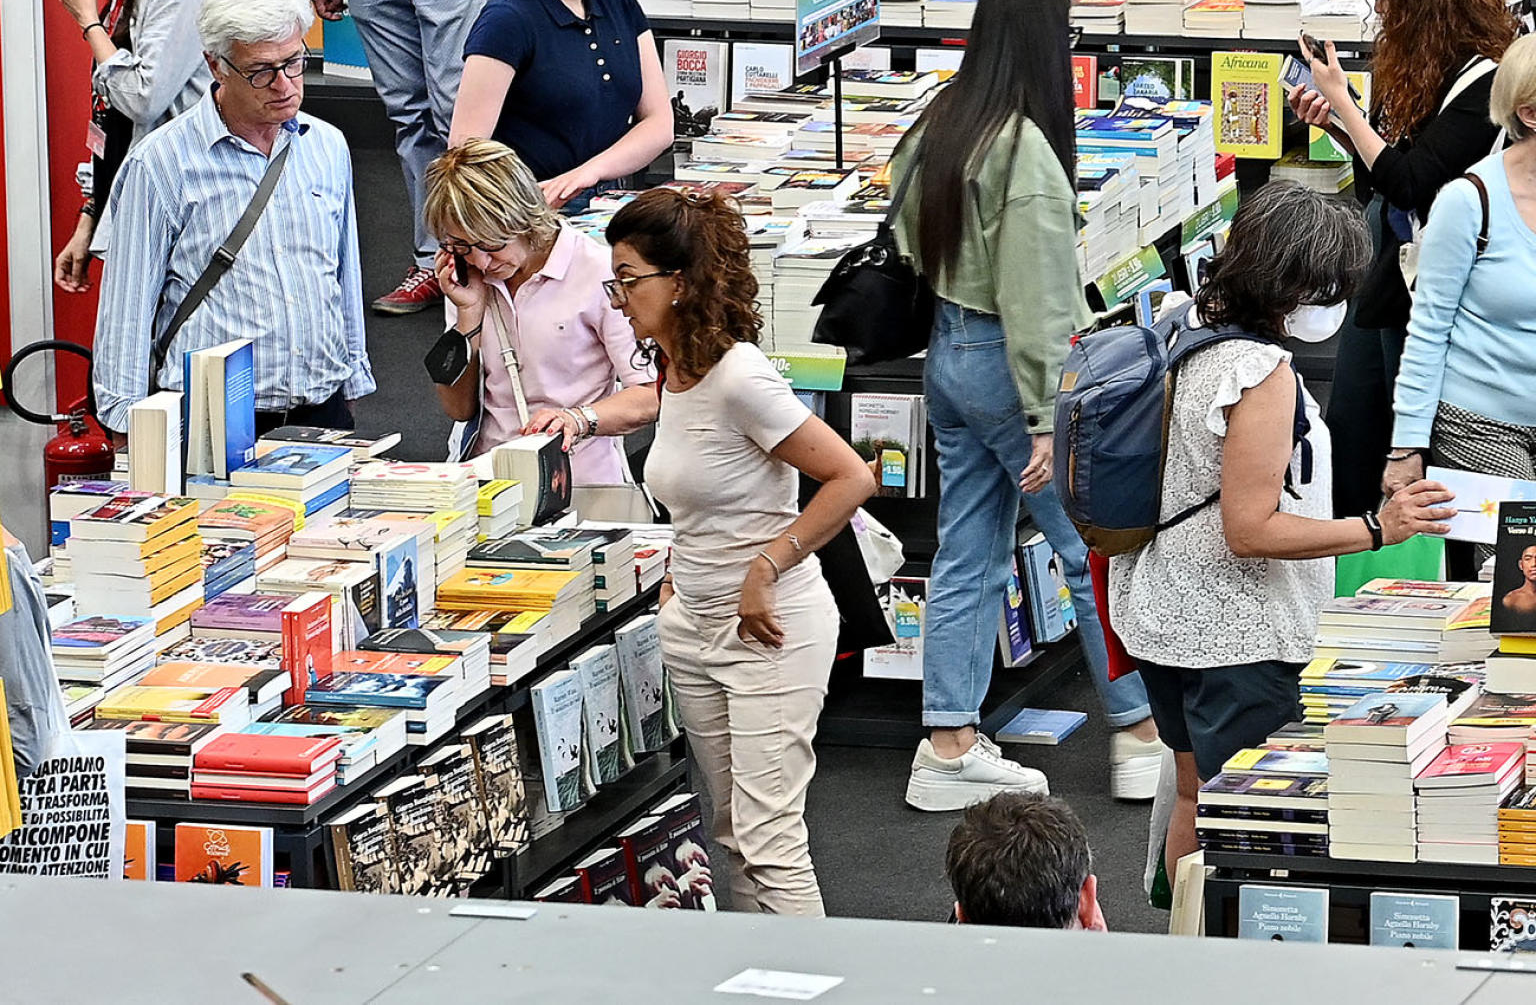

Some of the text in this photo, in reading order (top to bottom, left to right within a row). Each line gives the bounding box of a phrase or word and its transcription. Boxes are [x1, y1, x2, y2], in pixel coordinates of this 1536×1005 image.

[677, 59, 706, 71] BOCCA
[1220, 55, 1269, 70] Africana
[32, 757, 105, 778] UARDIANO
[19, 774, 106, 796] LTRA PARTE
[37, 792, 109, 810] TRASFORMA
[31, 813, 43, 824] DI
[11, 823, 110, 845] RICOMPONE
[0, 842, 109, 863] OMENTO IN CUI
[0, 860, 110, 875] TIAMO ATTENZIONE
